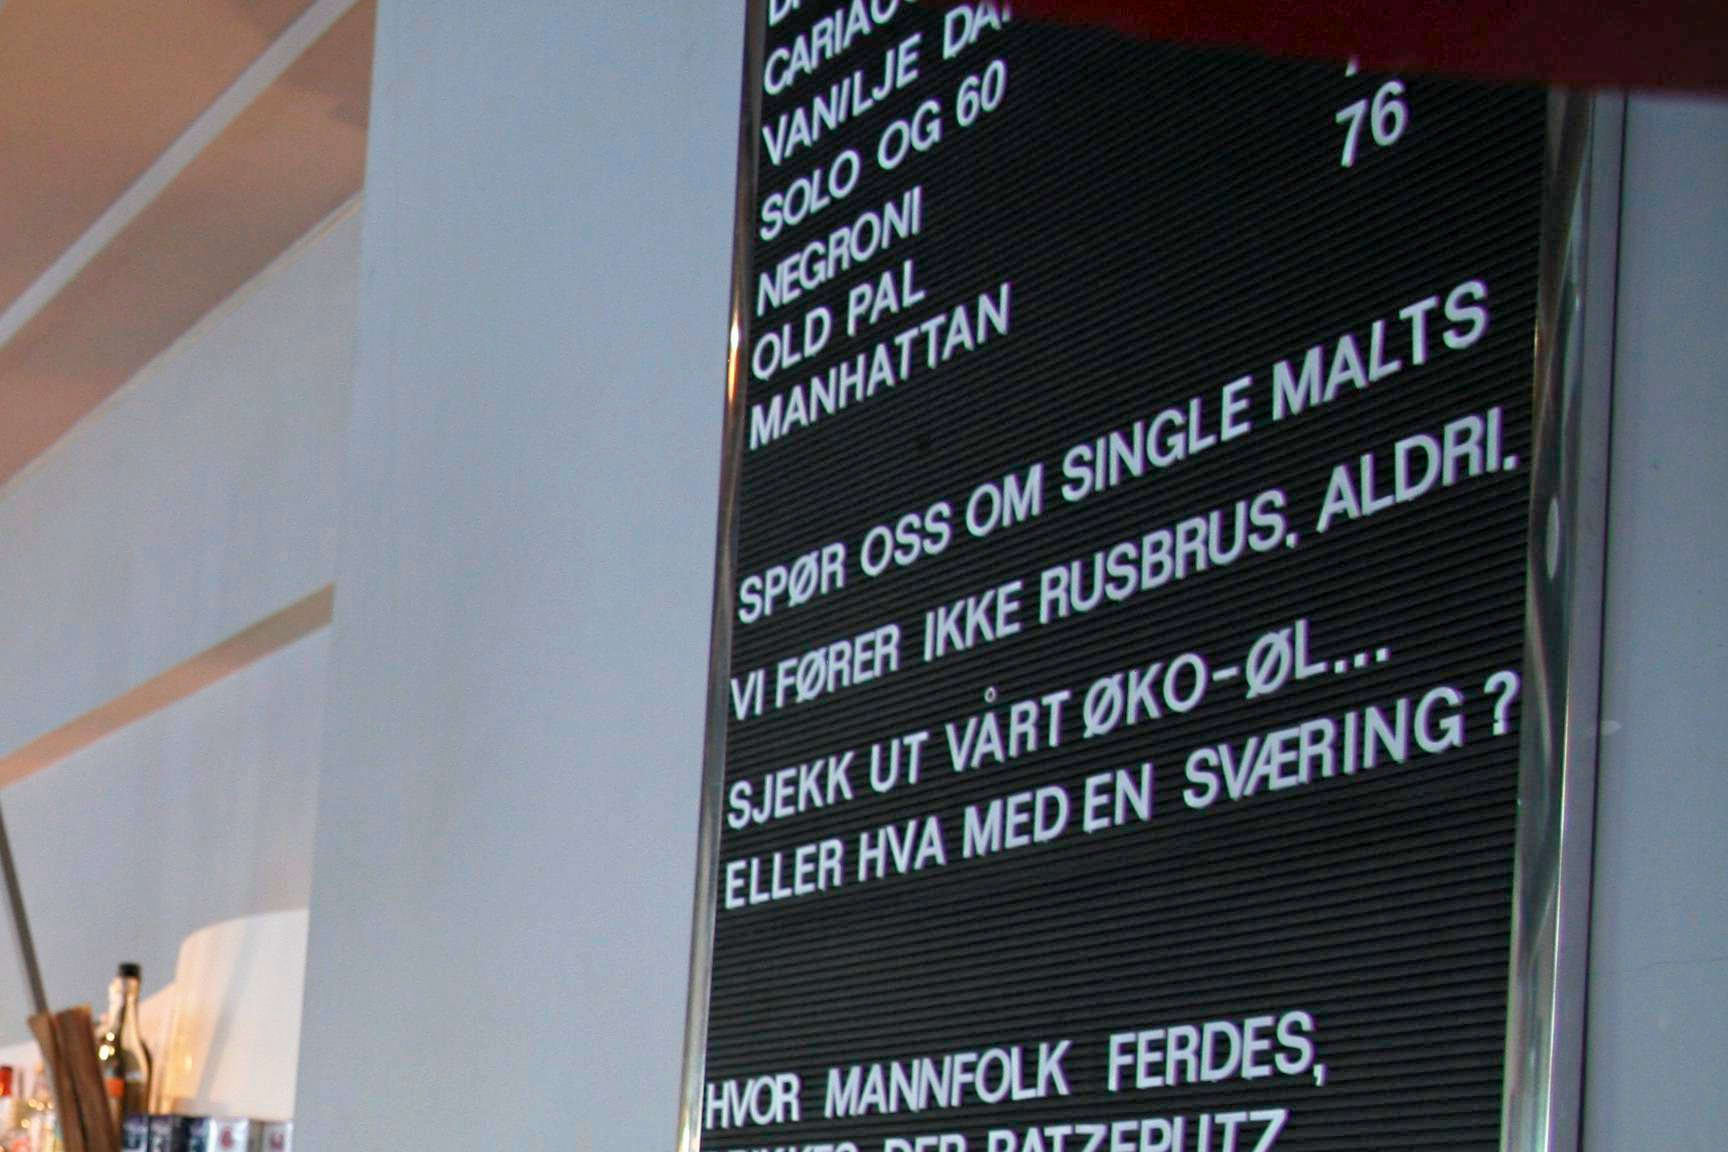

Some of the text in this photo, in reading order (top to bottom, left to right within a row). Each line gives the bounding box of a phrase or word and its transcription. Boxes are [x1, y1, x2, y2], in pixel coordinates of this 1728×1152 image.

[758, 58, 1007, 242] SOLO OG 60
[760, 32, 923, 167] VANILJE
[1334, 78, 1409, 168] 76
[750, 258, 927, 382] OLD PAL
[755, 185, 923, 318] NEGRONI
[748, 282, 1011, 452] MANHATTAN
[737, 280, 1488, 625] SPØR OSS OM SINGLE MALTS
[728, 668, 767, 722] VI
[773, 622, 902, 710] FØRER
[922, 579, 1024, 664] IKKE
[1315, 406, 1518, 534] ALDRI.
[725, 749, 857, 831] SJEKK
[868, 727, 931, 794] UT
[943, 685, 1073, 773] VÅRT
[723, 837, 846, 911] ELLER
[856, 814, 948, 883] HVA
[961, 785, 1071, 860] MED
[1081, 761, 1153, 835] EN
[703, 1009, 1327, 1131] HVOR MANNFOLK FERDES,
